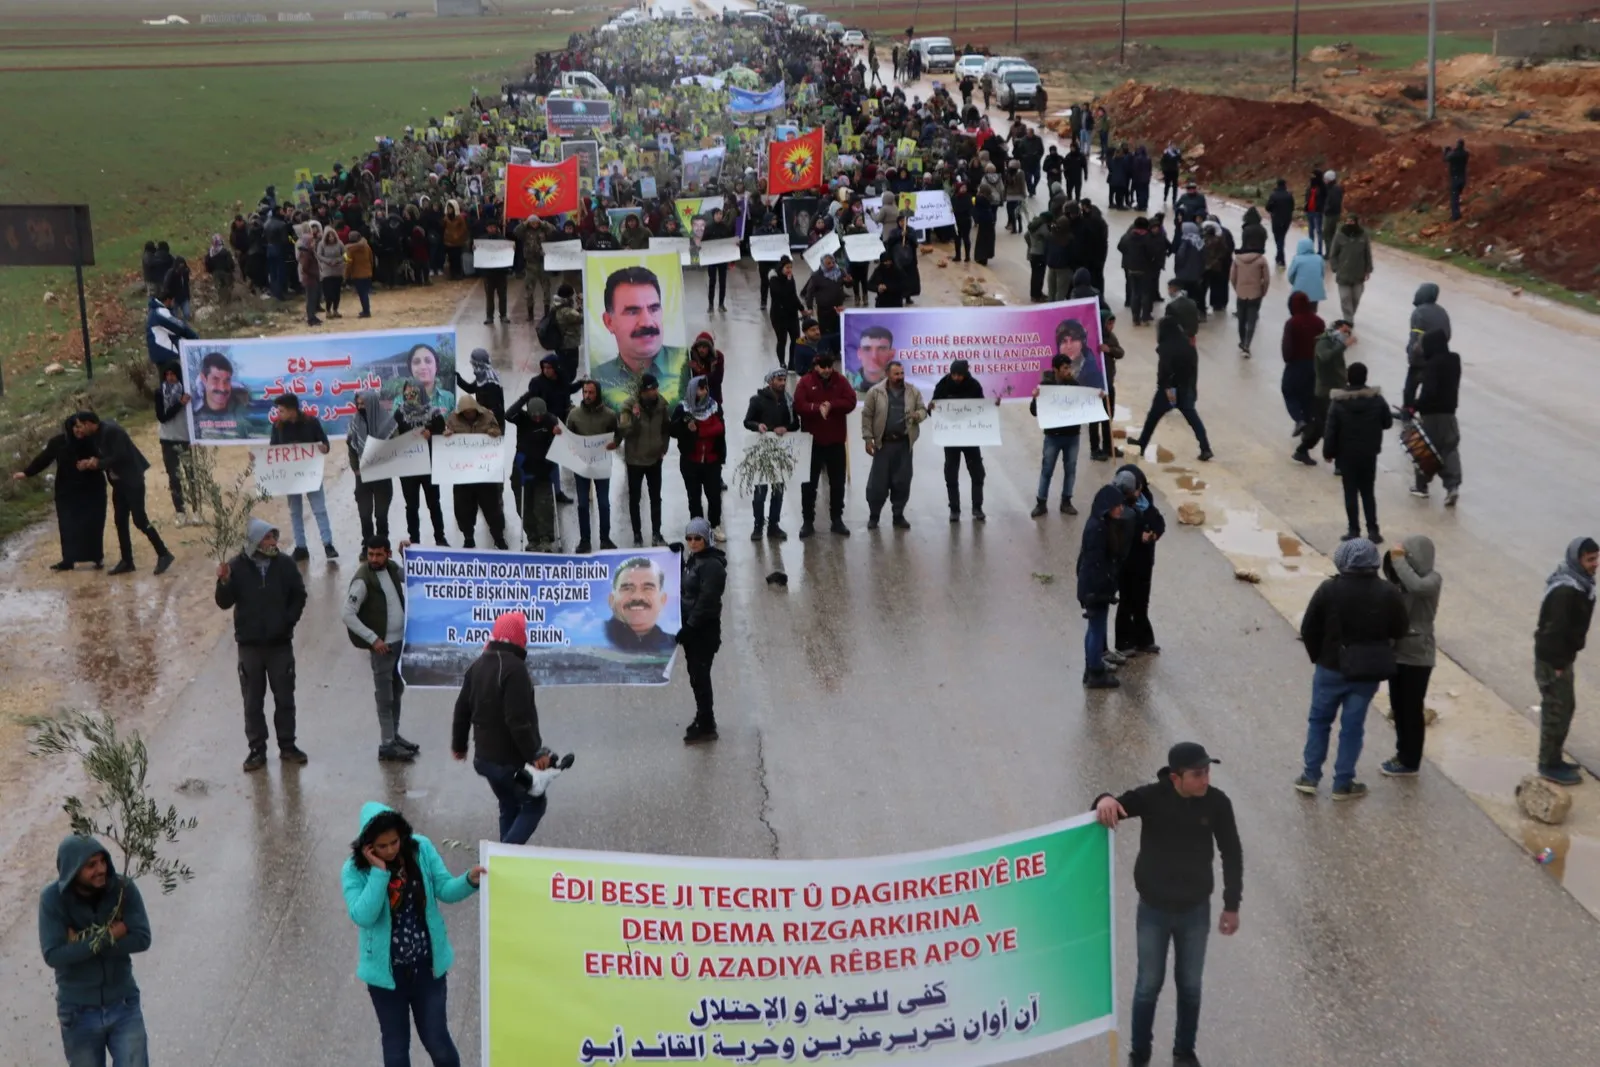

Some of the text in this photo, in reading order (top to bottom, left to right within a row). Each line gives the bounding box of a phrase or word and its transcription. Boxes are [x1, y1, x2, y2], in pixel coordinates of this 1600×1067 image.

[912, 336, 922, 345] BI
[953, 334, 1040, 345] BERXWEDANIYA
[1021, 347, 1052, 357] DARA
[288, 355, 351, 374] بروح
[974, 364, 984, 373] BI
[314, 380, 323, 396] و
[268, 400, 319, 424] عفن
[407, 557, 433, 576] HÛN
[490, 563, 521, 578] ROJA
[524, 565, 541, 579] ME
[545, 562, 573, 579] TARÎ
[425, 580, 473, 599] TECRÎDÊ
[539, 582, 589, 604] FAŞÎZMÊ
[551, 853, 1045, 909] ÊDI BESE JI TECRIT Û DAGIRKERIYÊ RE
[623, 903, 980, 944] DEM DEMA RIZGARKIRINA
[585, 929, 1017, 978] EFRÎN Û AZADIYA RÊBER APO YE
[814, 989, 889, 1021] للعزلة
[897, 980, 948, 1015] كفى
[794, 1000, 807, 1024] و
[963, 1000, 1008, 1041] أوان
[580, 1027, 624, 1063] أبو
[631, 1032, 705, 1059] القائد
[712, 1033, 795, 1063] وحرية
